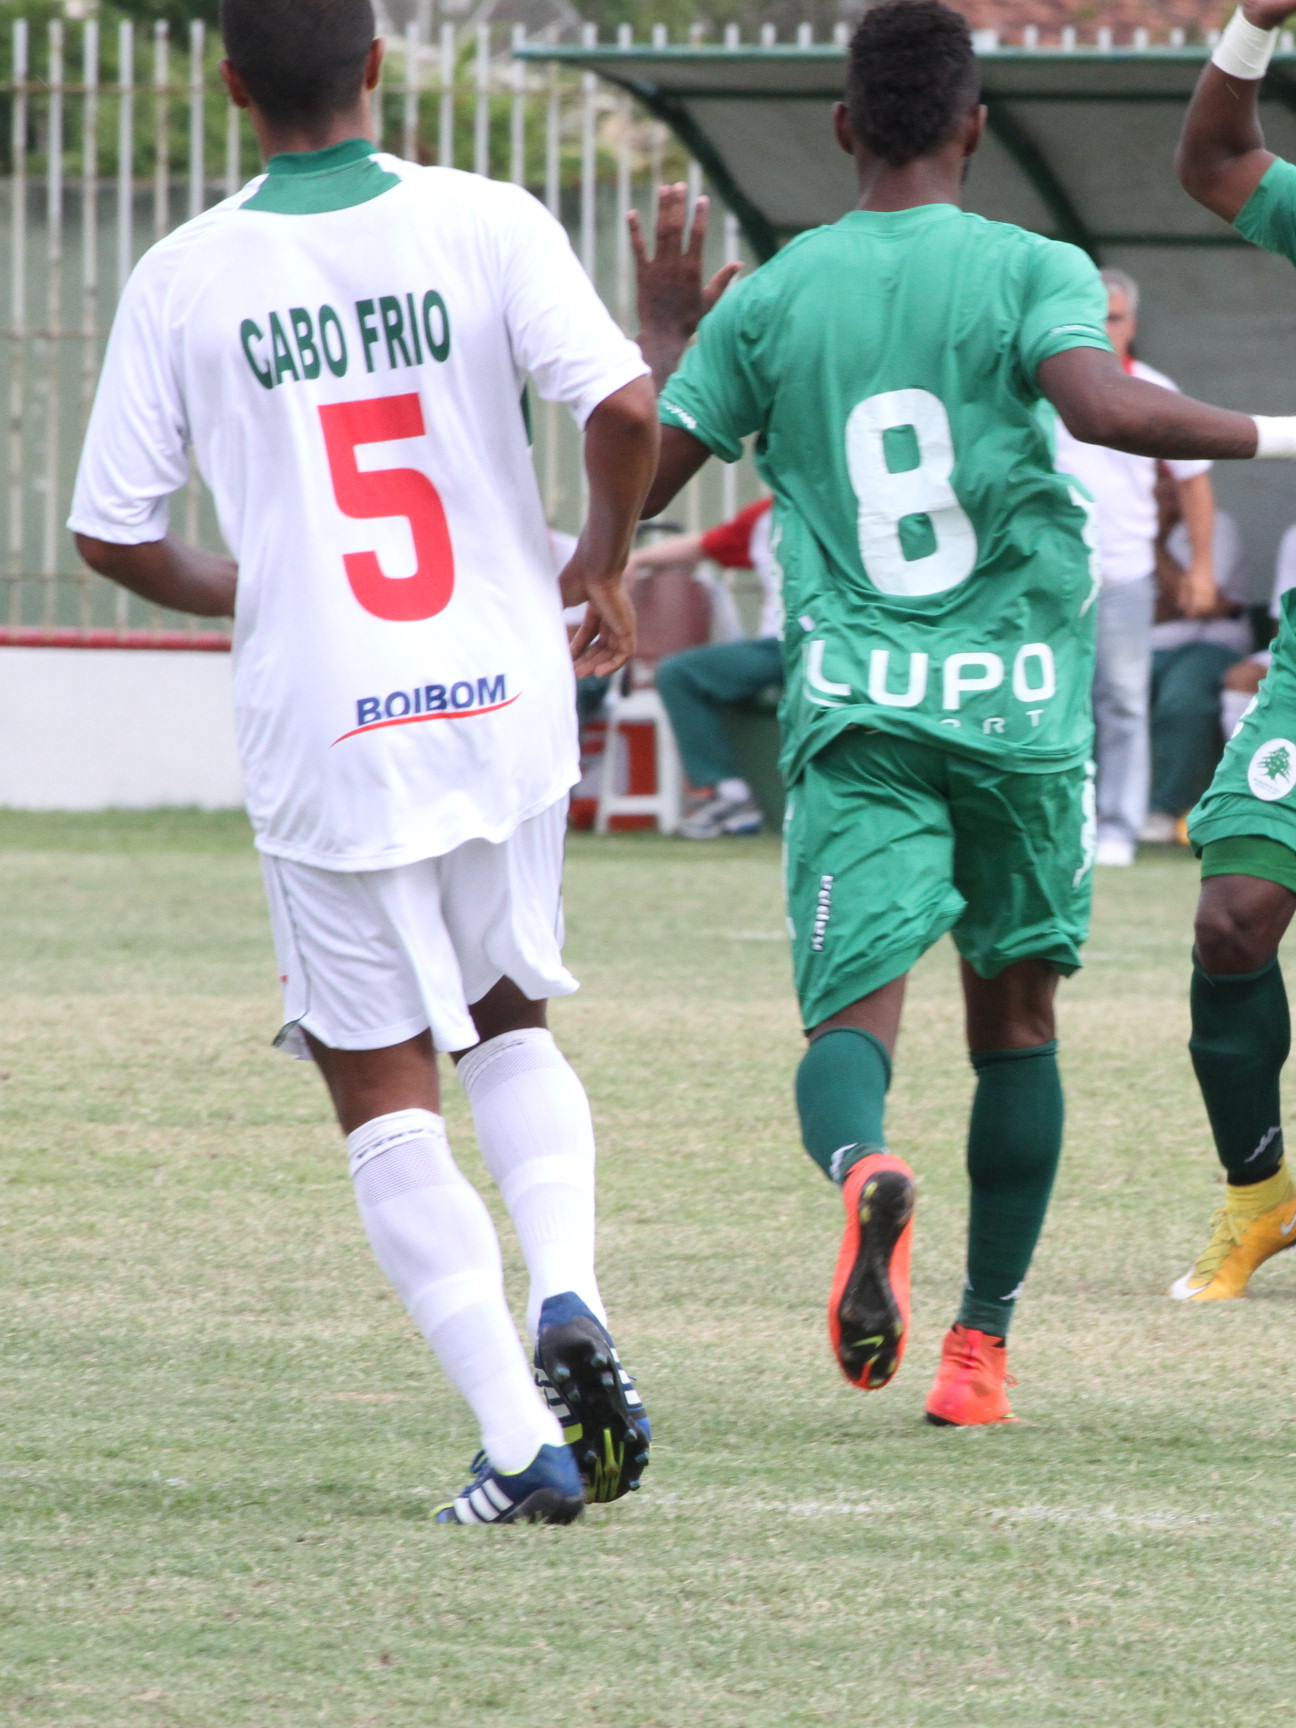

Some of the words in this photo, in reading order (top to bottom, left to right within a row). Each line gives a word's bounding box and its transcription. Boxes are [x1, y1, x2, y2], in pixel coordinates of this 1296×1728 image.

[239, 303, 349, 390] CABO
[355, 289, 451, 374] FRIO
[317, 391, 455, 622] 5
[845, 388, 977, 597] 8
[355, 674, 507, 727] BOIBOM
[802, 639, 1056, 710] LUPO
